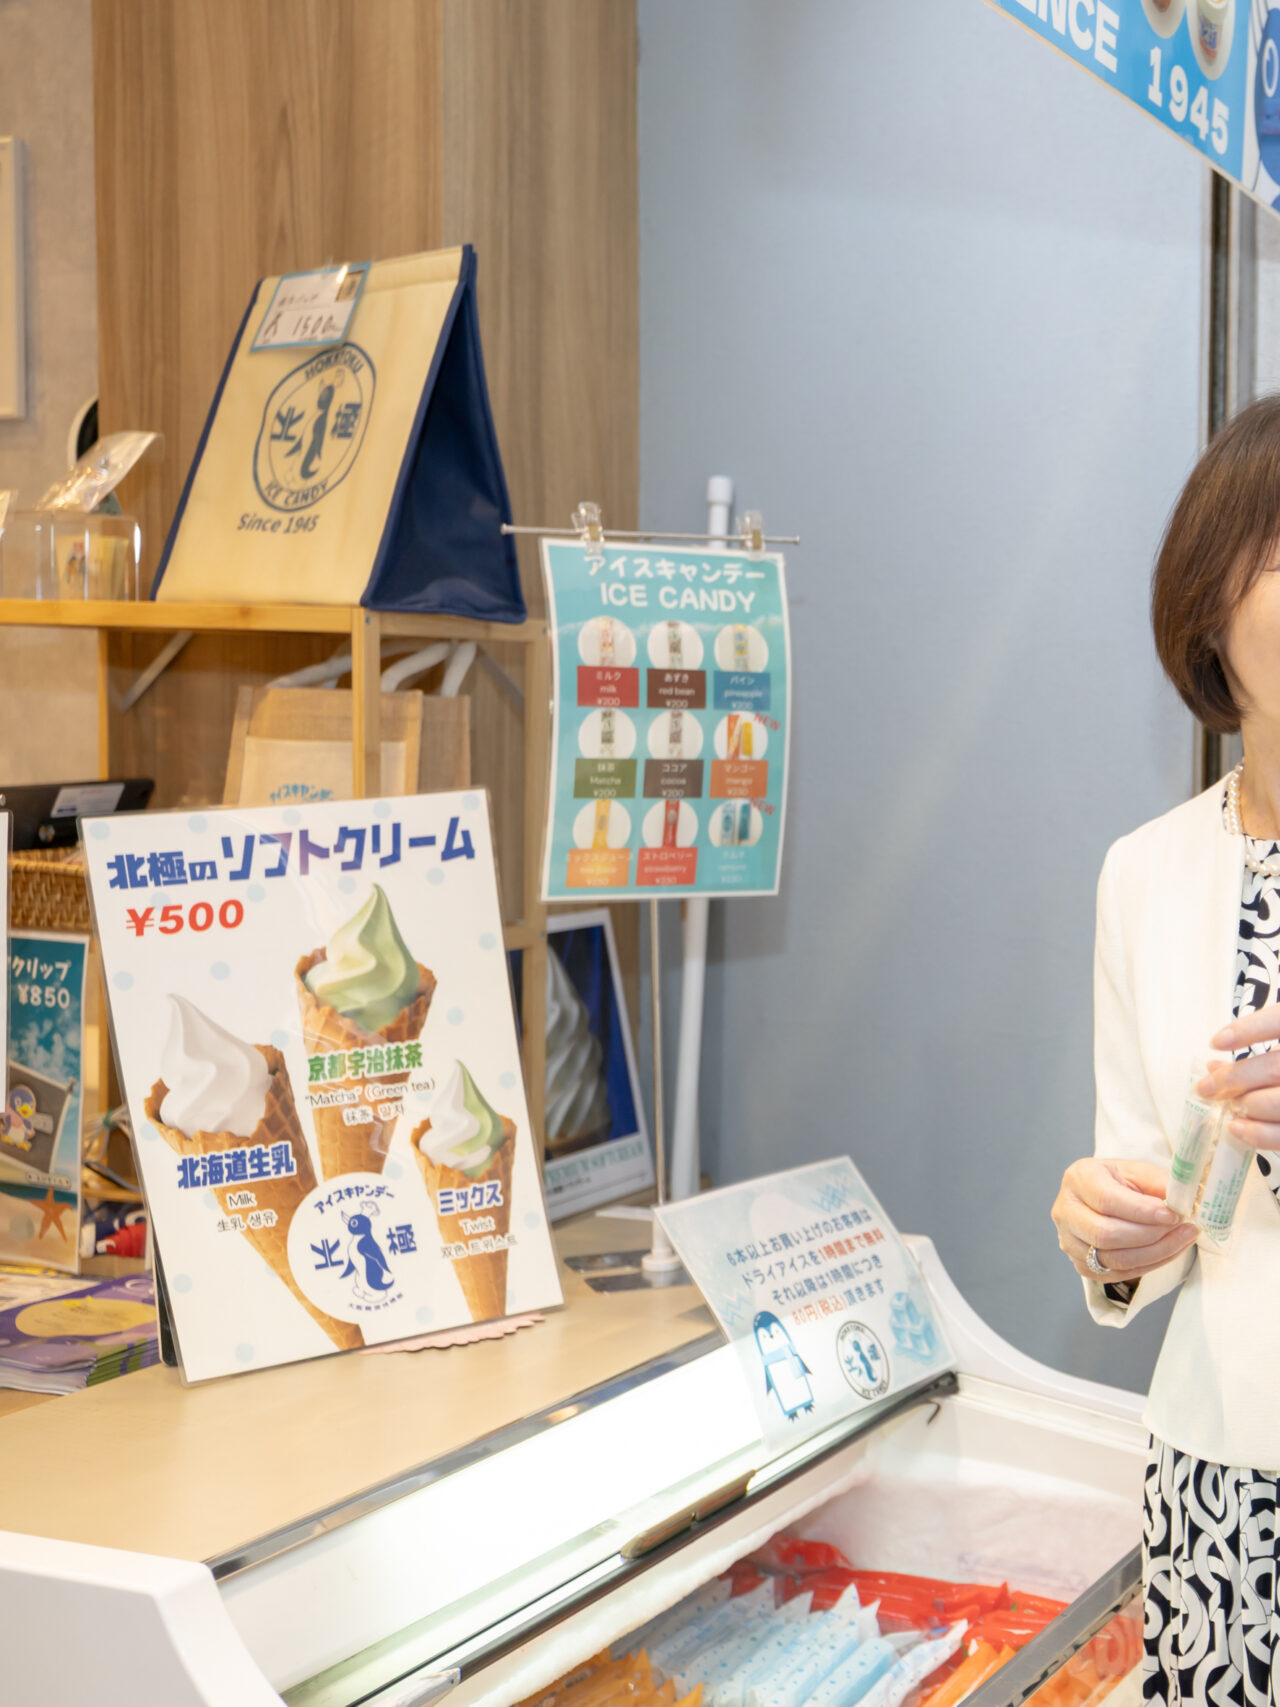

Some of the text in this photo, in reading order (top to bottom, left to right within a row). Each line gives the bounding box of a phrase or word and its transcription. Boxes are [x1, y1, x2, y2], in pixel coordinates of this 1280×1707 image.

[1148, 46, 1230, 155] 1945
[237, 512, 320, 534] Since 1945
[584, 554, 765, 584] アイスキャンデー
[601, 582, 756, 613] ICE CANDY
[596, 671, 621, 681] ミルク
[597, 698, 620, 706] ¥200
[600, 685, 617, 694] milk
[659, 687, 673, 696] red
[666, 700, 688, 709] ¥200
[754, 712, 781, 732] NEW
[662, 764, 688, 773] ココア
[593, 789, 616, 798] ¥200
[662, 789, 685, 798] ¥200
[749, 797, 776, 815] NEW
[106, 816, 476, 890] 北極のソフトクリーム
[125, 899, 245, 937] ¥500
[8, 955, 71, 982] クリップ
[18, 983, 70, 1009] ¥850
[308, 1042, 424, 1082] 京都宇治抹茶
[366, 1083, 408, 1102] (Green
[412, 1077, 436, 1091] tea)
[177, 1144, 294, 1189] 北海道生乳
[228, 1193, 255, 1208] Milk
[314, 1184, 395, 1214] アイスキャンデー
[439, 1183, 501, 1213] ミックス
[462, 1218, 494, 1233] Twist
[386, 1223, 417, 1256] 極
[310, 1238, 345, 1270] 北
